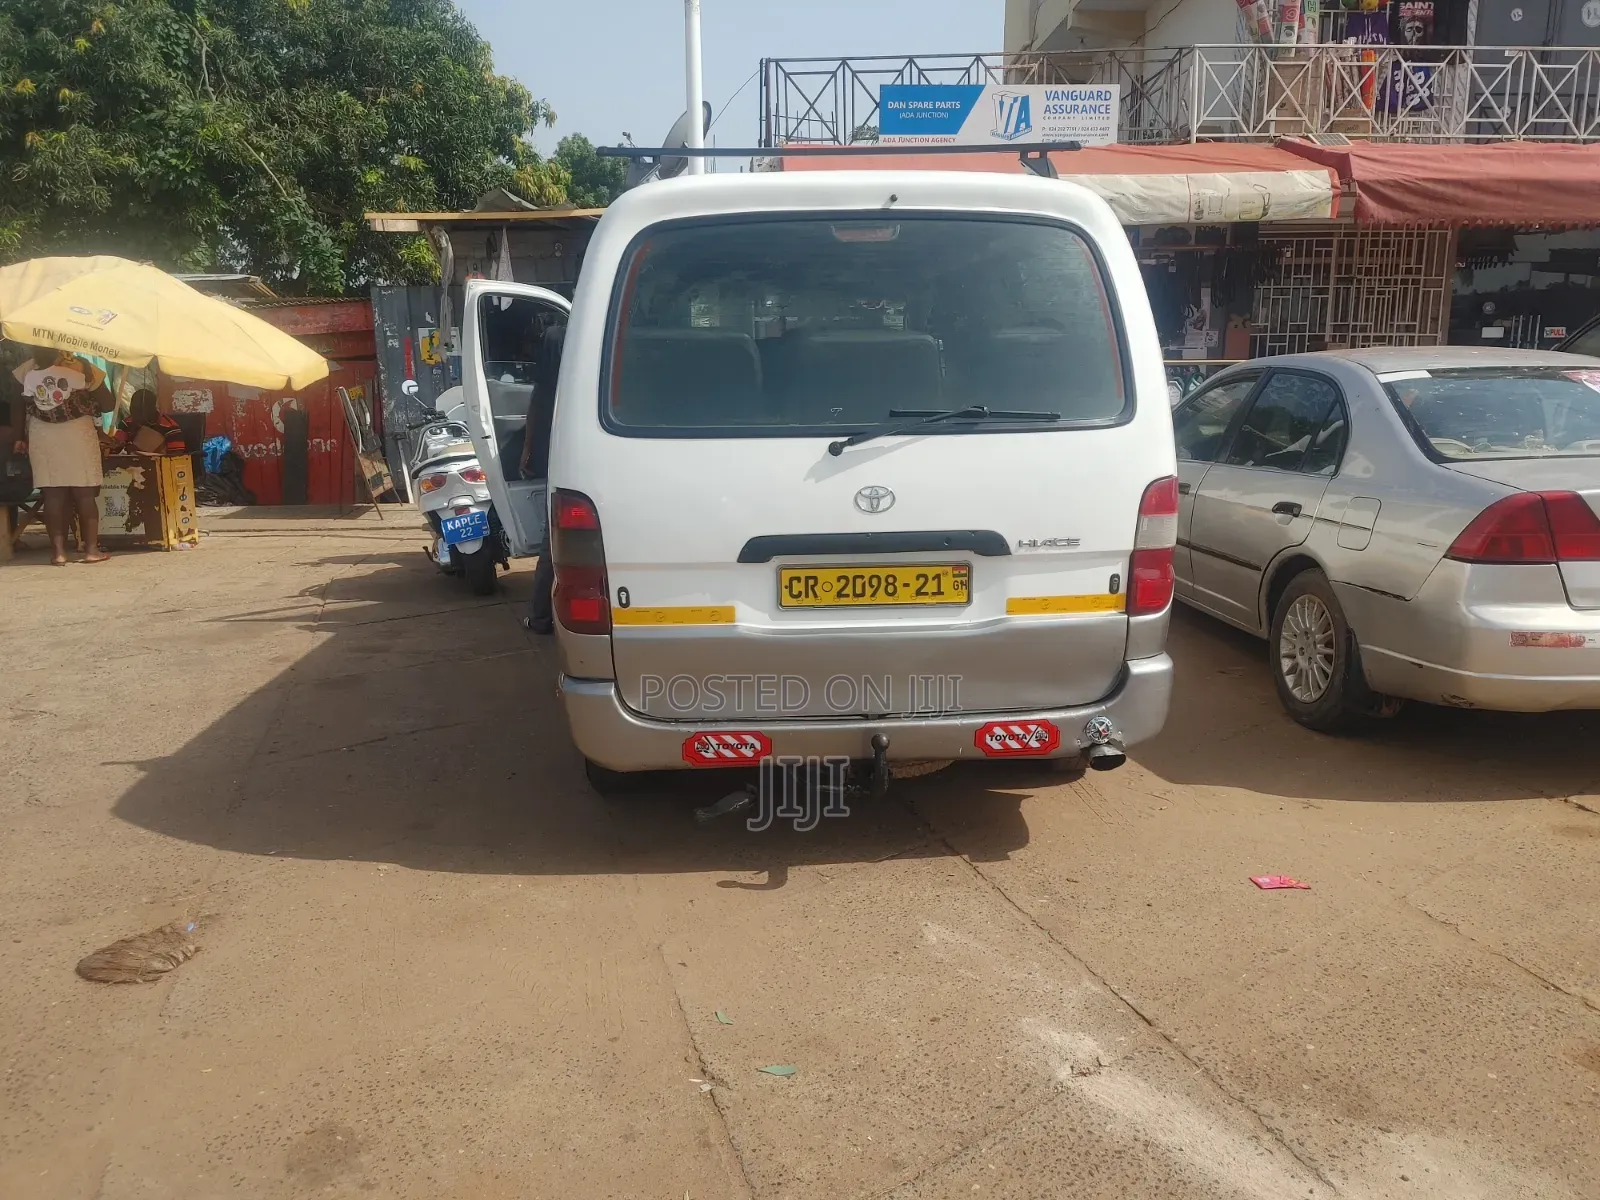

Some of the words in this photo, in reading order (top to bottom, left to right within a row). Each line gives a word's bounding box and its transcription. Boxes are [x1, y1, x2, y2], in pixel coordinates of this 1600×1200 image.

[1045, 90, 1112, 101] VANGUARD
[888, 101, 906, 109] DAN
[908, 101, 934, 109] SPARE
[935, 101, 961, 109] PARTS
[1044, 104, 1111, 114] ASSURANCE
[899, 111, 914, 119] (ADA
[915, 111, 949, 119] JUNCTION)
[898, 136, 930, 144] JUNCTION
[1550, 328, 1565, 336] PULL
[32, 327, 54, 341] MTN
[57, 332, 89, 348] Mobile
[89, 341, 120, 358] Money
[239, 438, 337, 458] vodne
[446, 514, 482, 530] KAPLE
[460, 526, 474, 538] 22
[1018, 537, 1081, 547] HIACE
[952, 579, 968, 591] GH
[988, 733, 1028, 742] TOYOTA
[715, 742, 757, 750] TOYOTA
